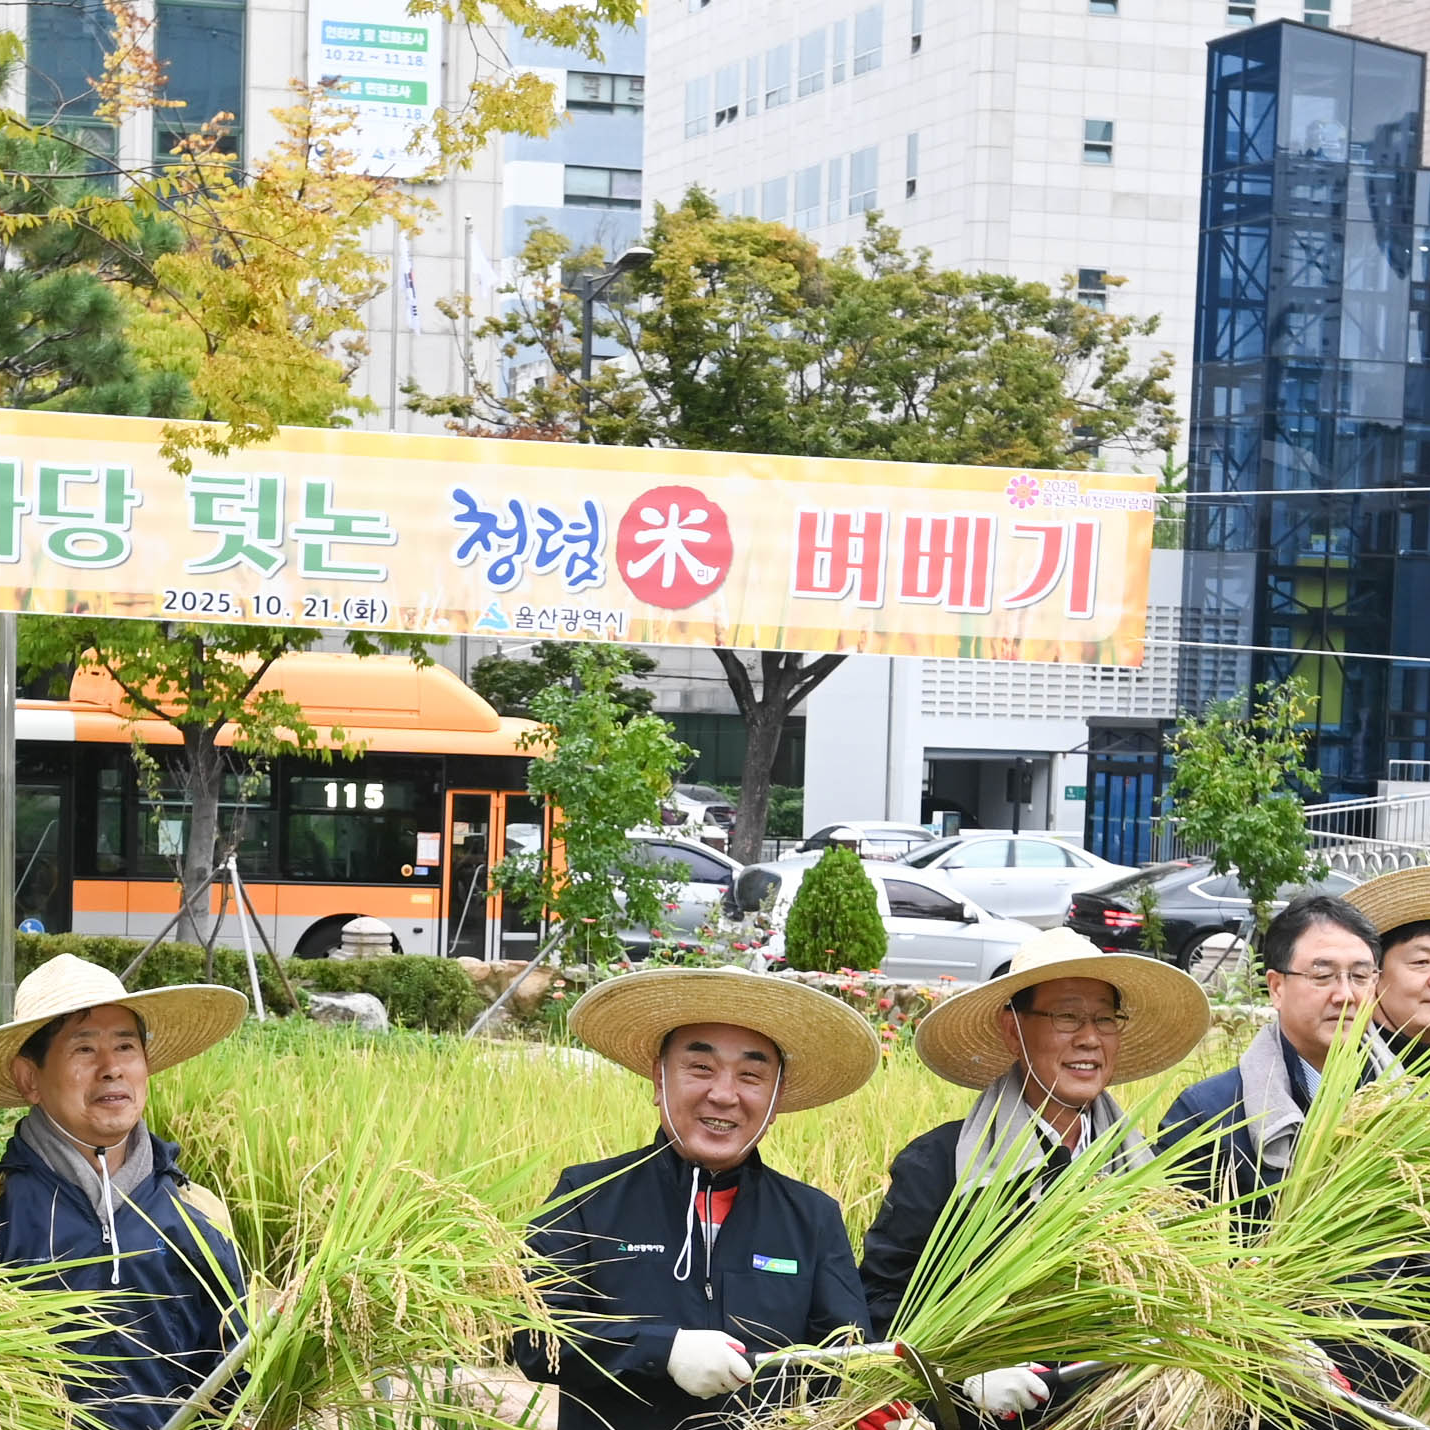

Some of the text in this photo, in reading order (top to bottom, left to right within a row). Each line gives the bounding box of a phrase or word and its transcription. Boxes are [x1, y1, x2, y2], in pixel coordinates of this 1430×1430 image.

[1043, 481, 1077, 493] 2028
[184, 473, 395, 579] 텃논
[793, 509, 1095, 615] 벼베기
[163, 590, 389, 623] 2025. 10. 21.(화)
[514, 605, 625, 633] 울산광역시
[324, 782, 385, 809] 115
